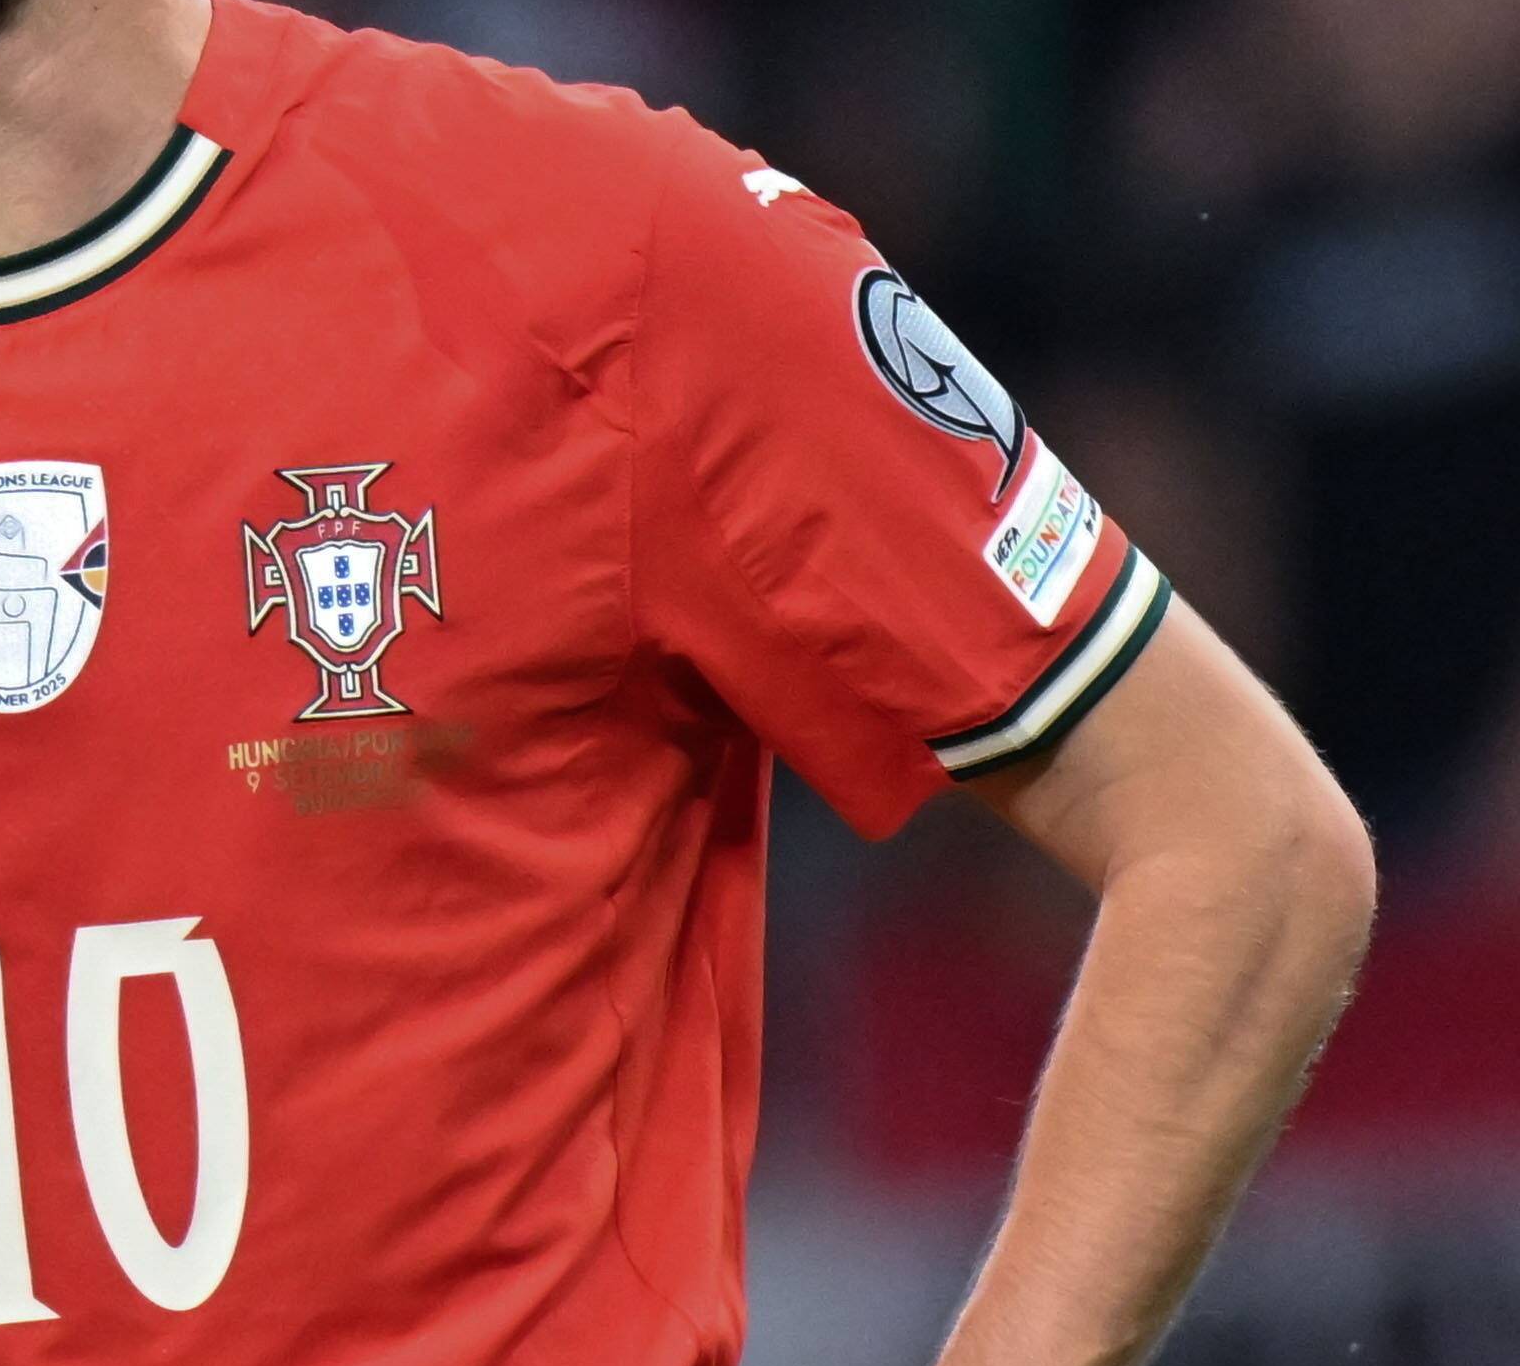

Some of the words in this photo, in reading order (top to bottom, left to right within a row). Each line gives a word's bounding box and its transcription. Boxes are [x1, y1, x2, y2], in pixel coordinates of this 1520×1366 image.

[31, 473, 93, 490] LEAGUE
[993, 526, 1021, 568] UEFA
[32, 673, 66, 702] 2025
[246, 770, 262, 794] 9
